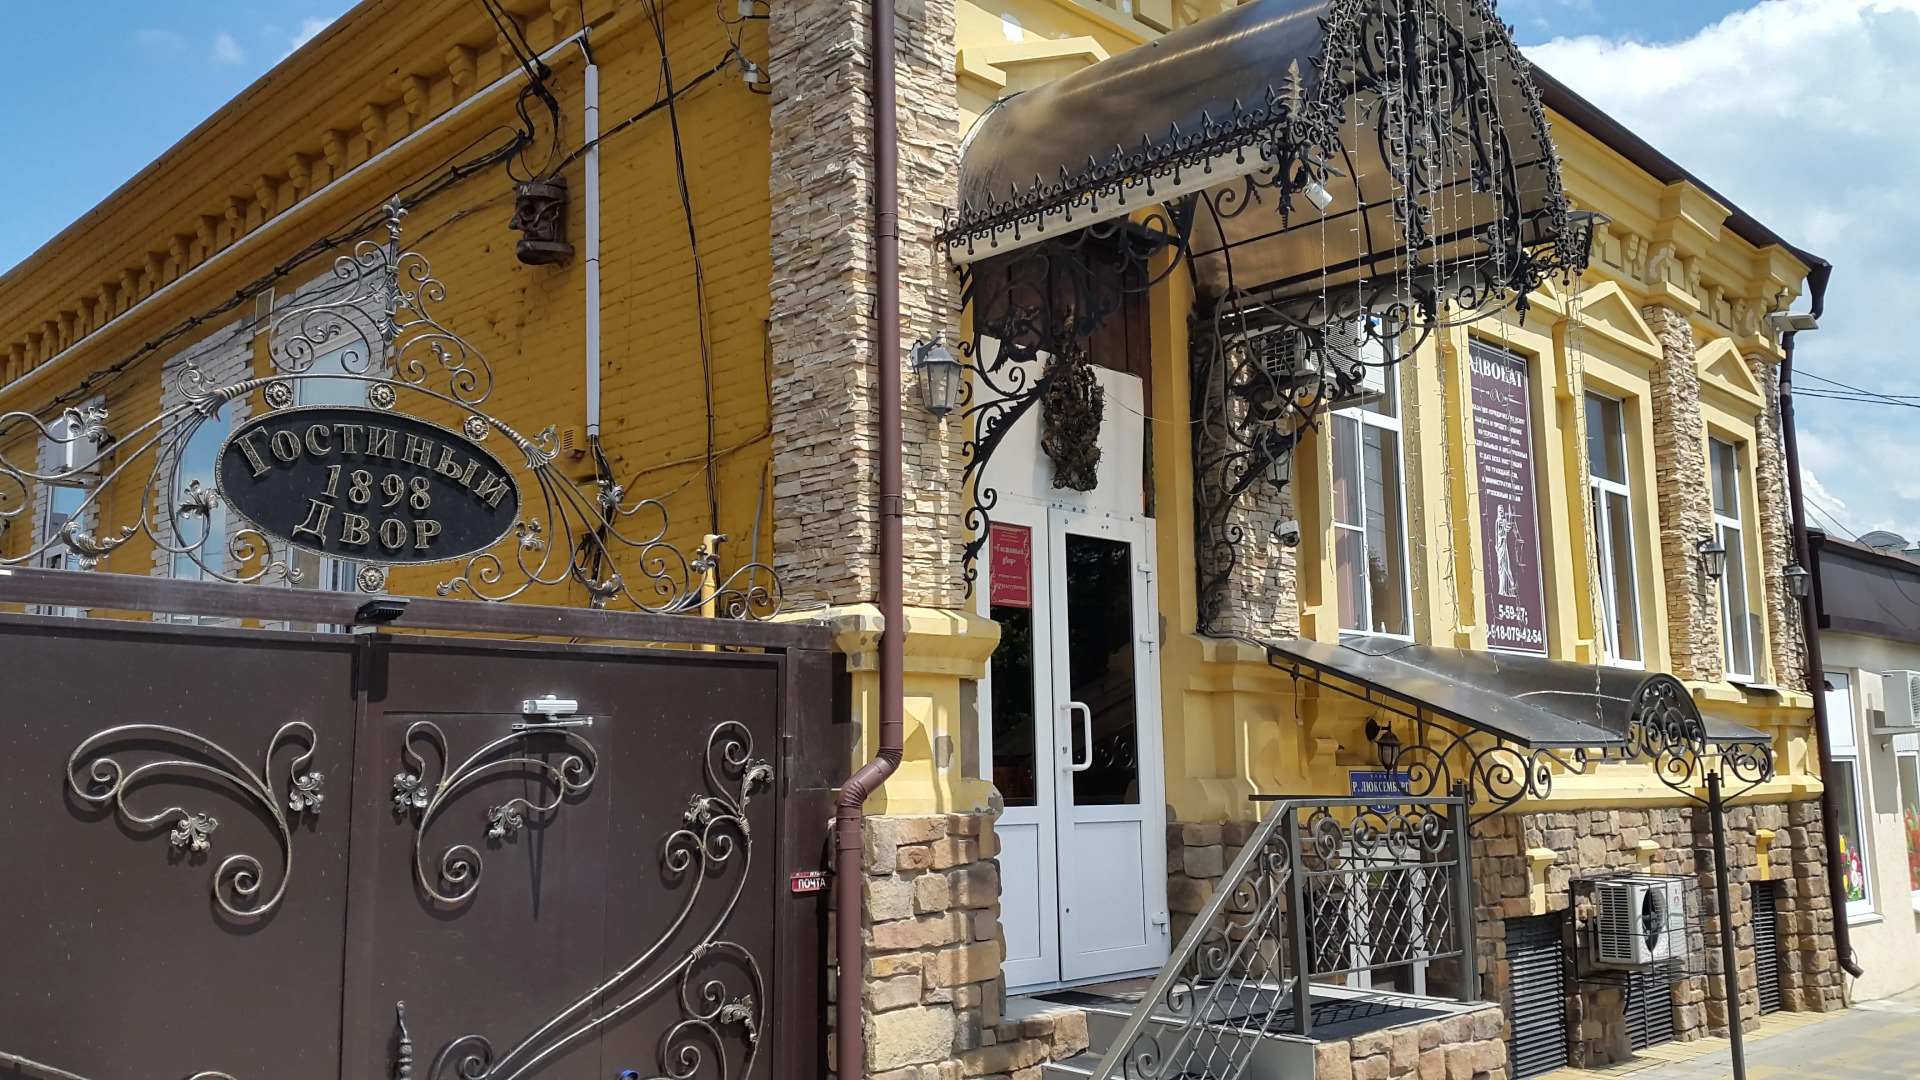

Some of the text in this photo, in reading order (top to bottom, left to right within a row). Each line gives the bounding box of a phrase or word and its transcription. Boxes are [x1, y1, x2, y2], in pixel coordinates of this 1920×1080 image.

[232, 424, 511, 509] ГОСТИНЫЙ
[321, 464, 431, 510] 1898
[292, 498, 442, 550] ДВОР
[1361, 781, 1409, 792] ЛЮКСЕМБРГ
[798, 877, 826, 889] ПОЧТА
